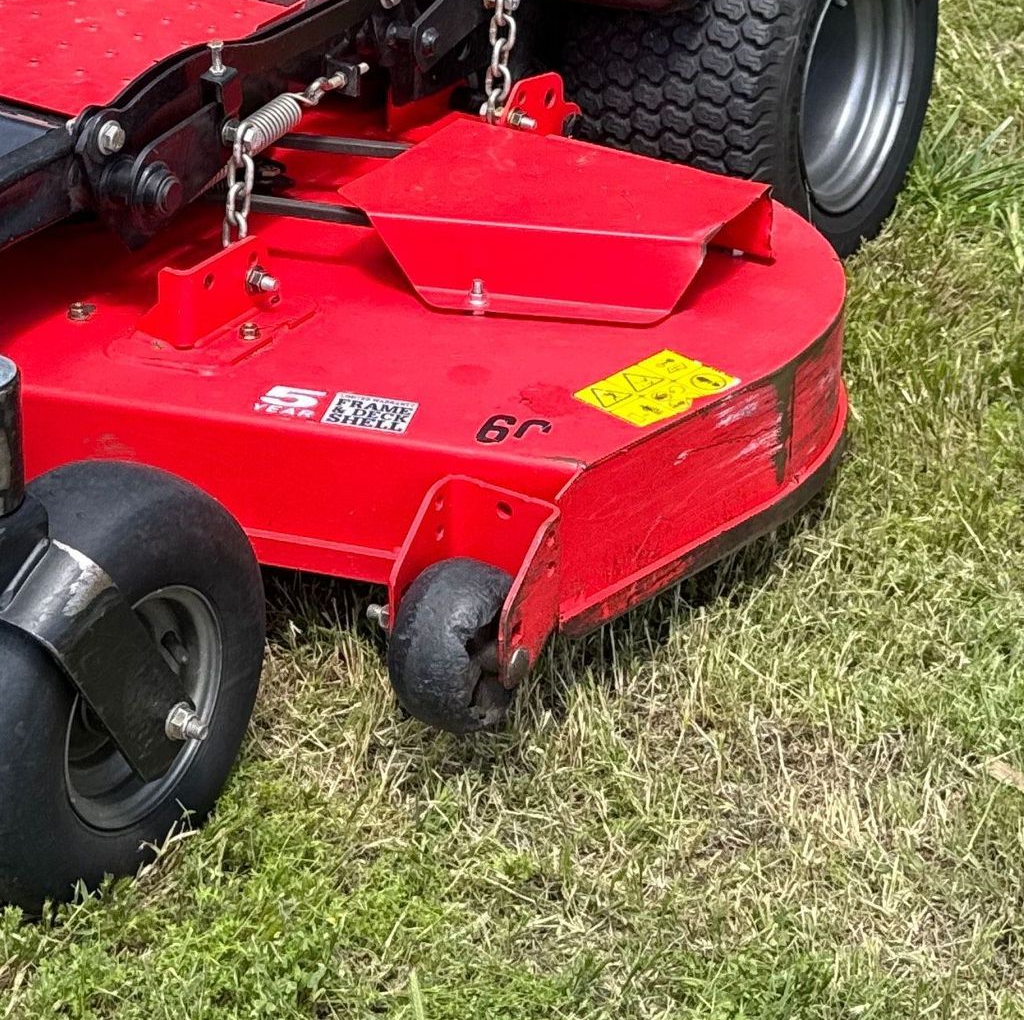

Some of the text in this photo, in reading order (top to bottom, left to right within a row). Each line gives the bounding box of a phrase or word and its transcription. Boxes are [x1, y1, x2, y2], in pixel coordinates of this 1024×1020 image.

[260, 385, 327, 408] 5
[253, 402, 316, 419] YEAR
[336, 398, 413, 416] FRAME
[352, 408, 408, 423] DECK
[326, 413, 403, 432] SHELL
